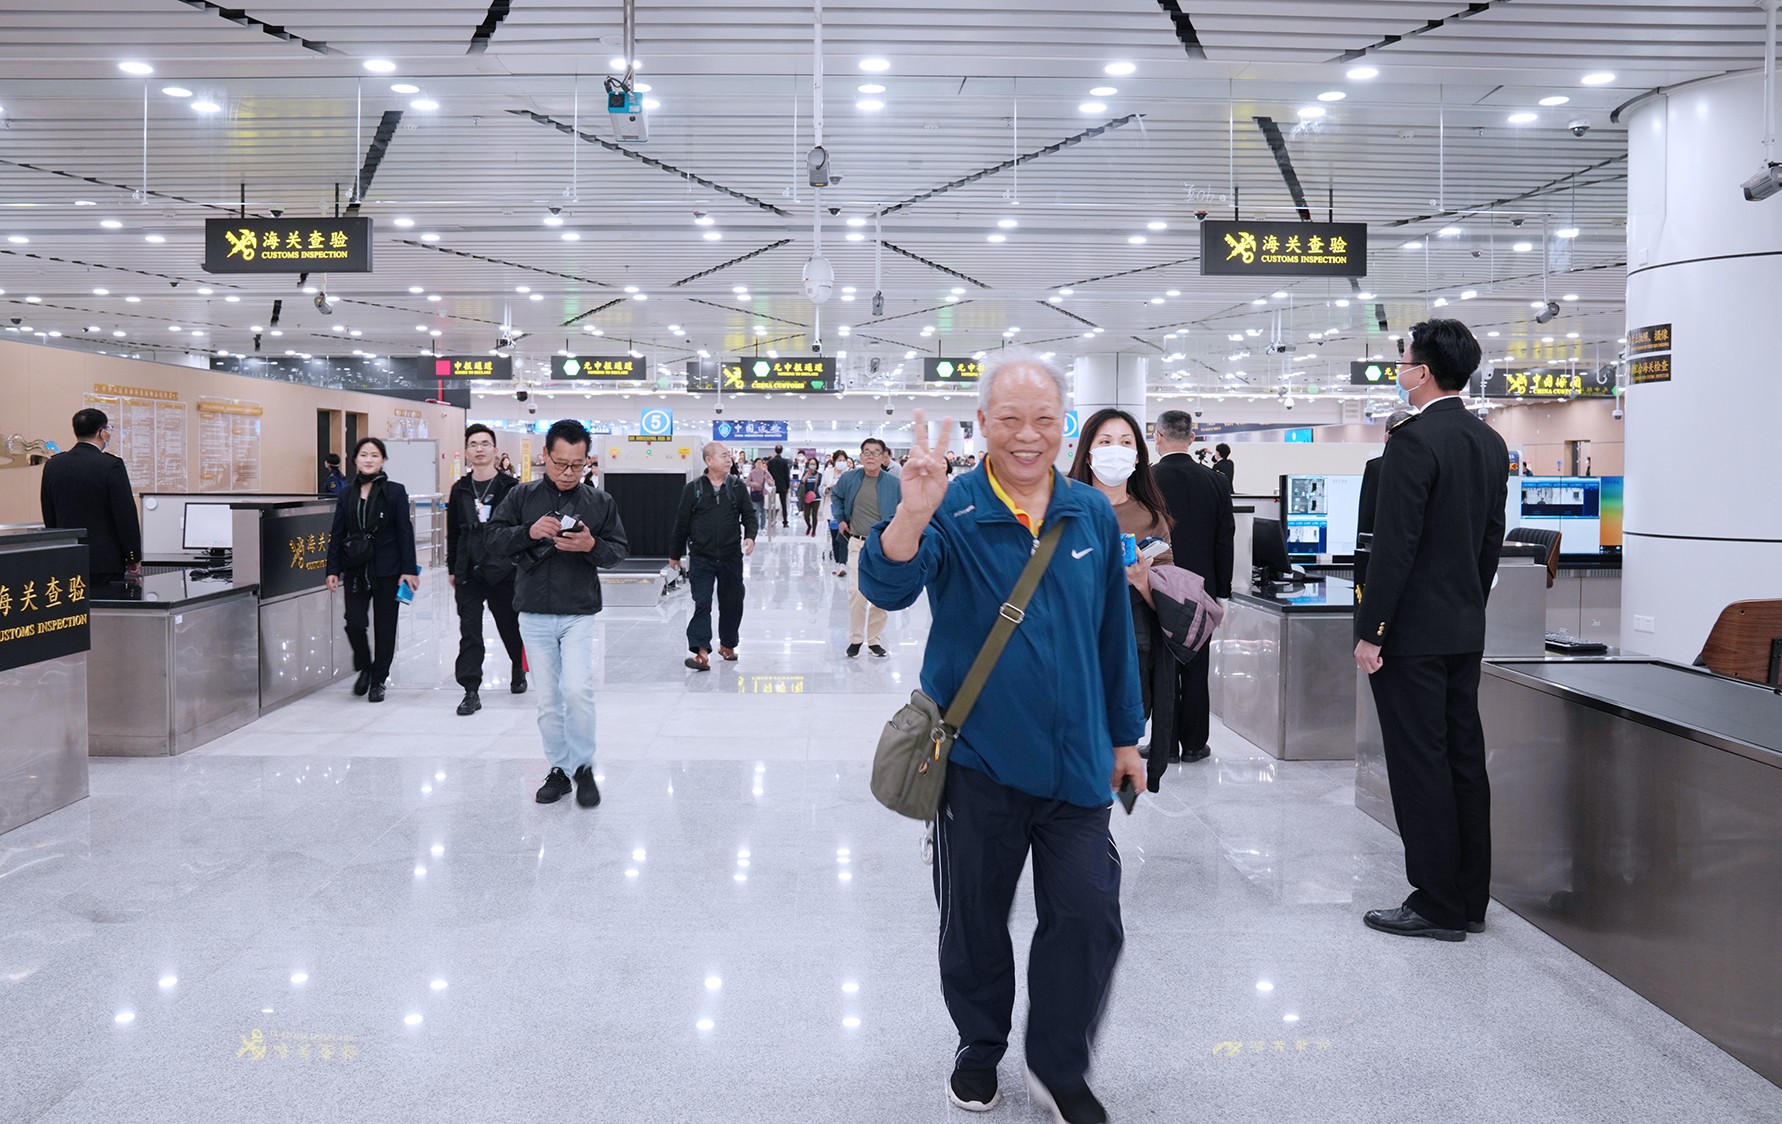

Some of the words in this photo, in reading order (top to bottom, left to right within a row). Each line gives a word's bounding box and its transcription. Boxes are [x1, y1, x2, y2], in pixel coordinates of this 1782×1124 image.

[262, 230, 348, 249] 海关查验
[1262, 235, 1348, 254] 海关查验
[261, 251, 299, 259] CUSTOMS
[301, 250, 348, 259] INSPECTION
[1261, 255, 1299, 263] CUSTOMS
[1300, 256, 1347, 264] INSPECTION
[651, 415, 661, 430] 5
[0, 575, 87, 617] 海关查验
[0, 624, 35, 642] USTOMS
[37, 614, 87, 634] INSPECTION
